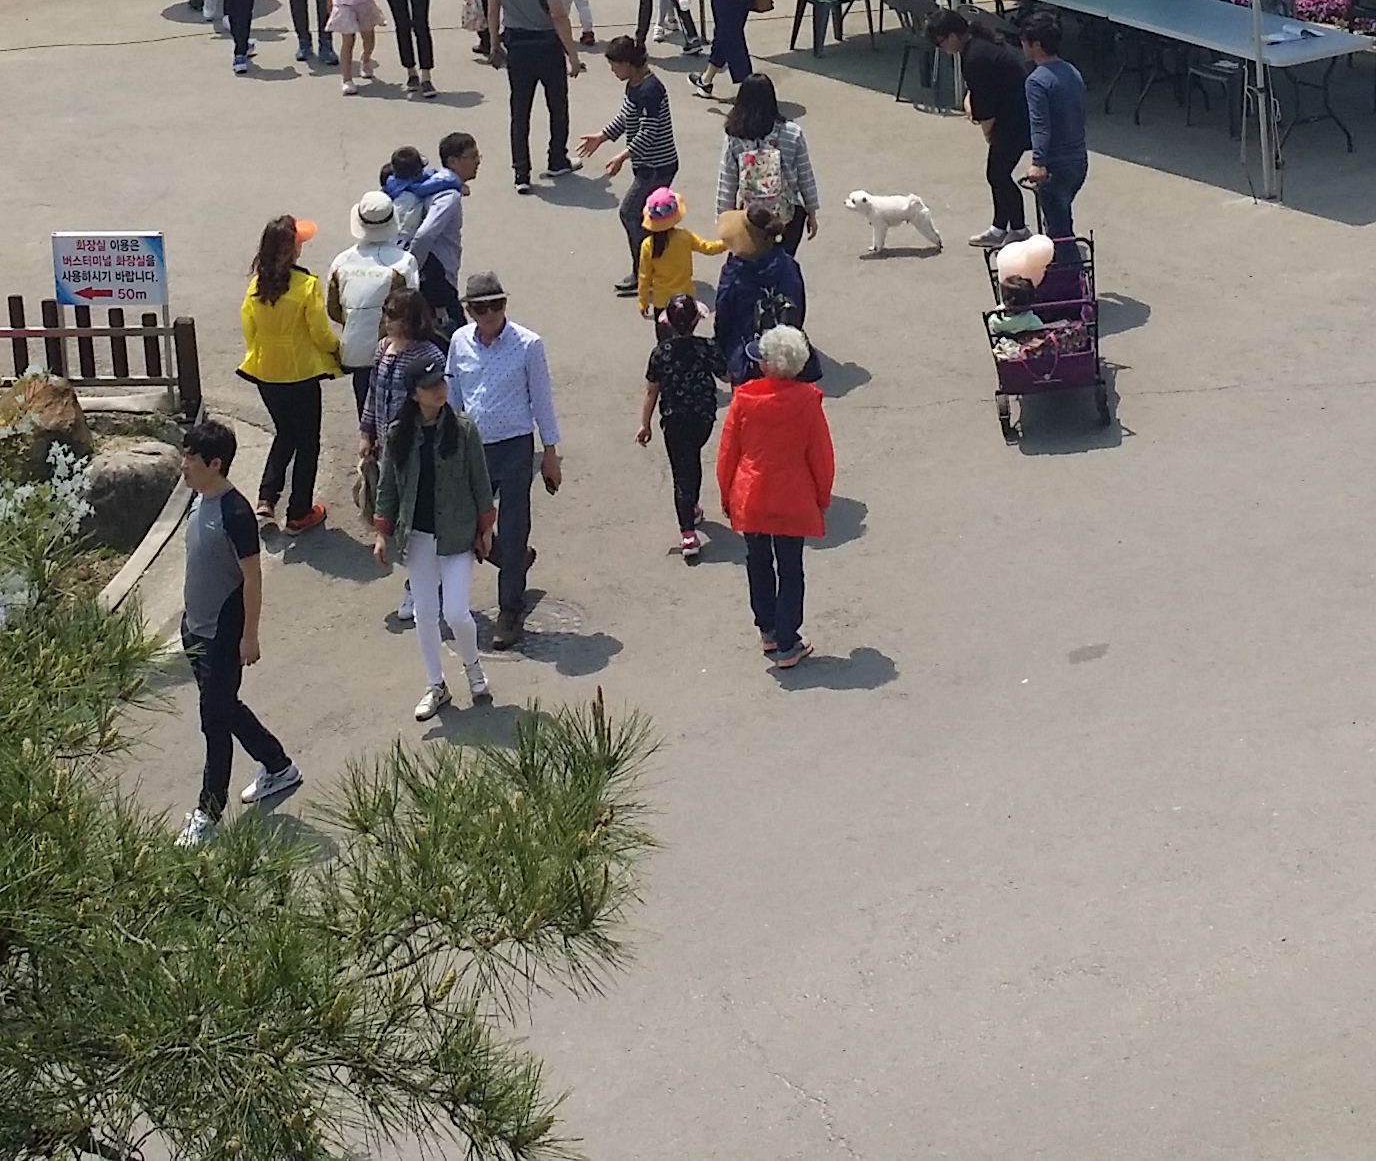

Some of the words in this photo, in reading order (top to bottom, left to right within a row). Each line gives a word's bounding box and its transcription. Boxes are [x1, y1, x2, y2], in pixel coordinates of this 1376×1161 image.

[76, 239, 106, 252] 화장실
[110, 239, 140, 252] 이용은
[62, 255, 112, 267] 버스터미널
[116, 254, 155, 267] 화장실을
[62, 270, 111, 283] 사용하시기
[115, 270, 159, 283] 바랍니다.
[118, 288, 147, 300] 50m
